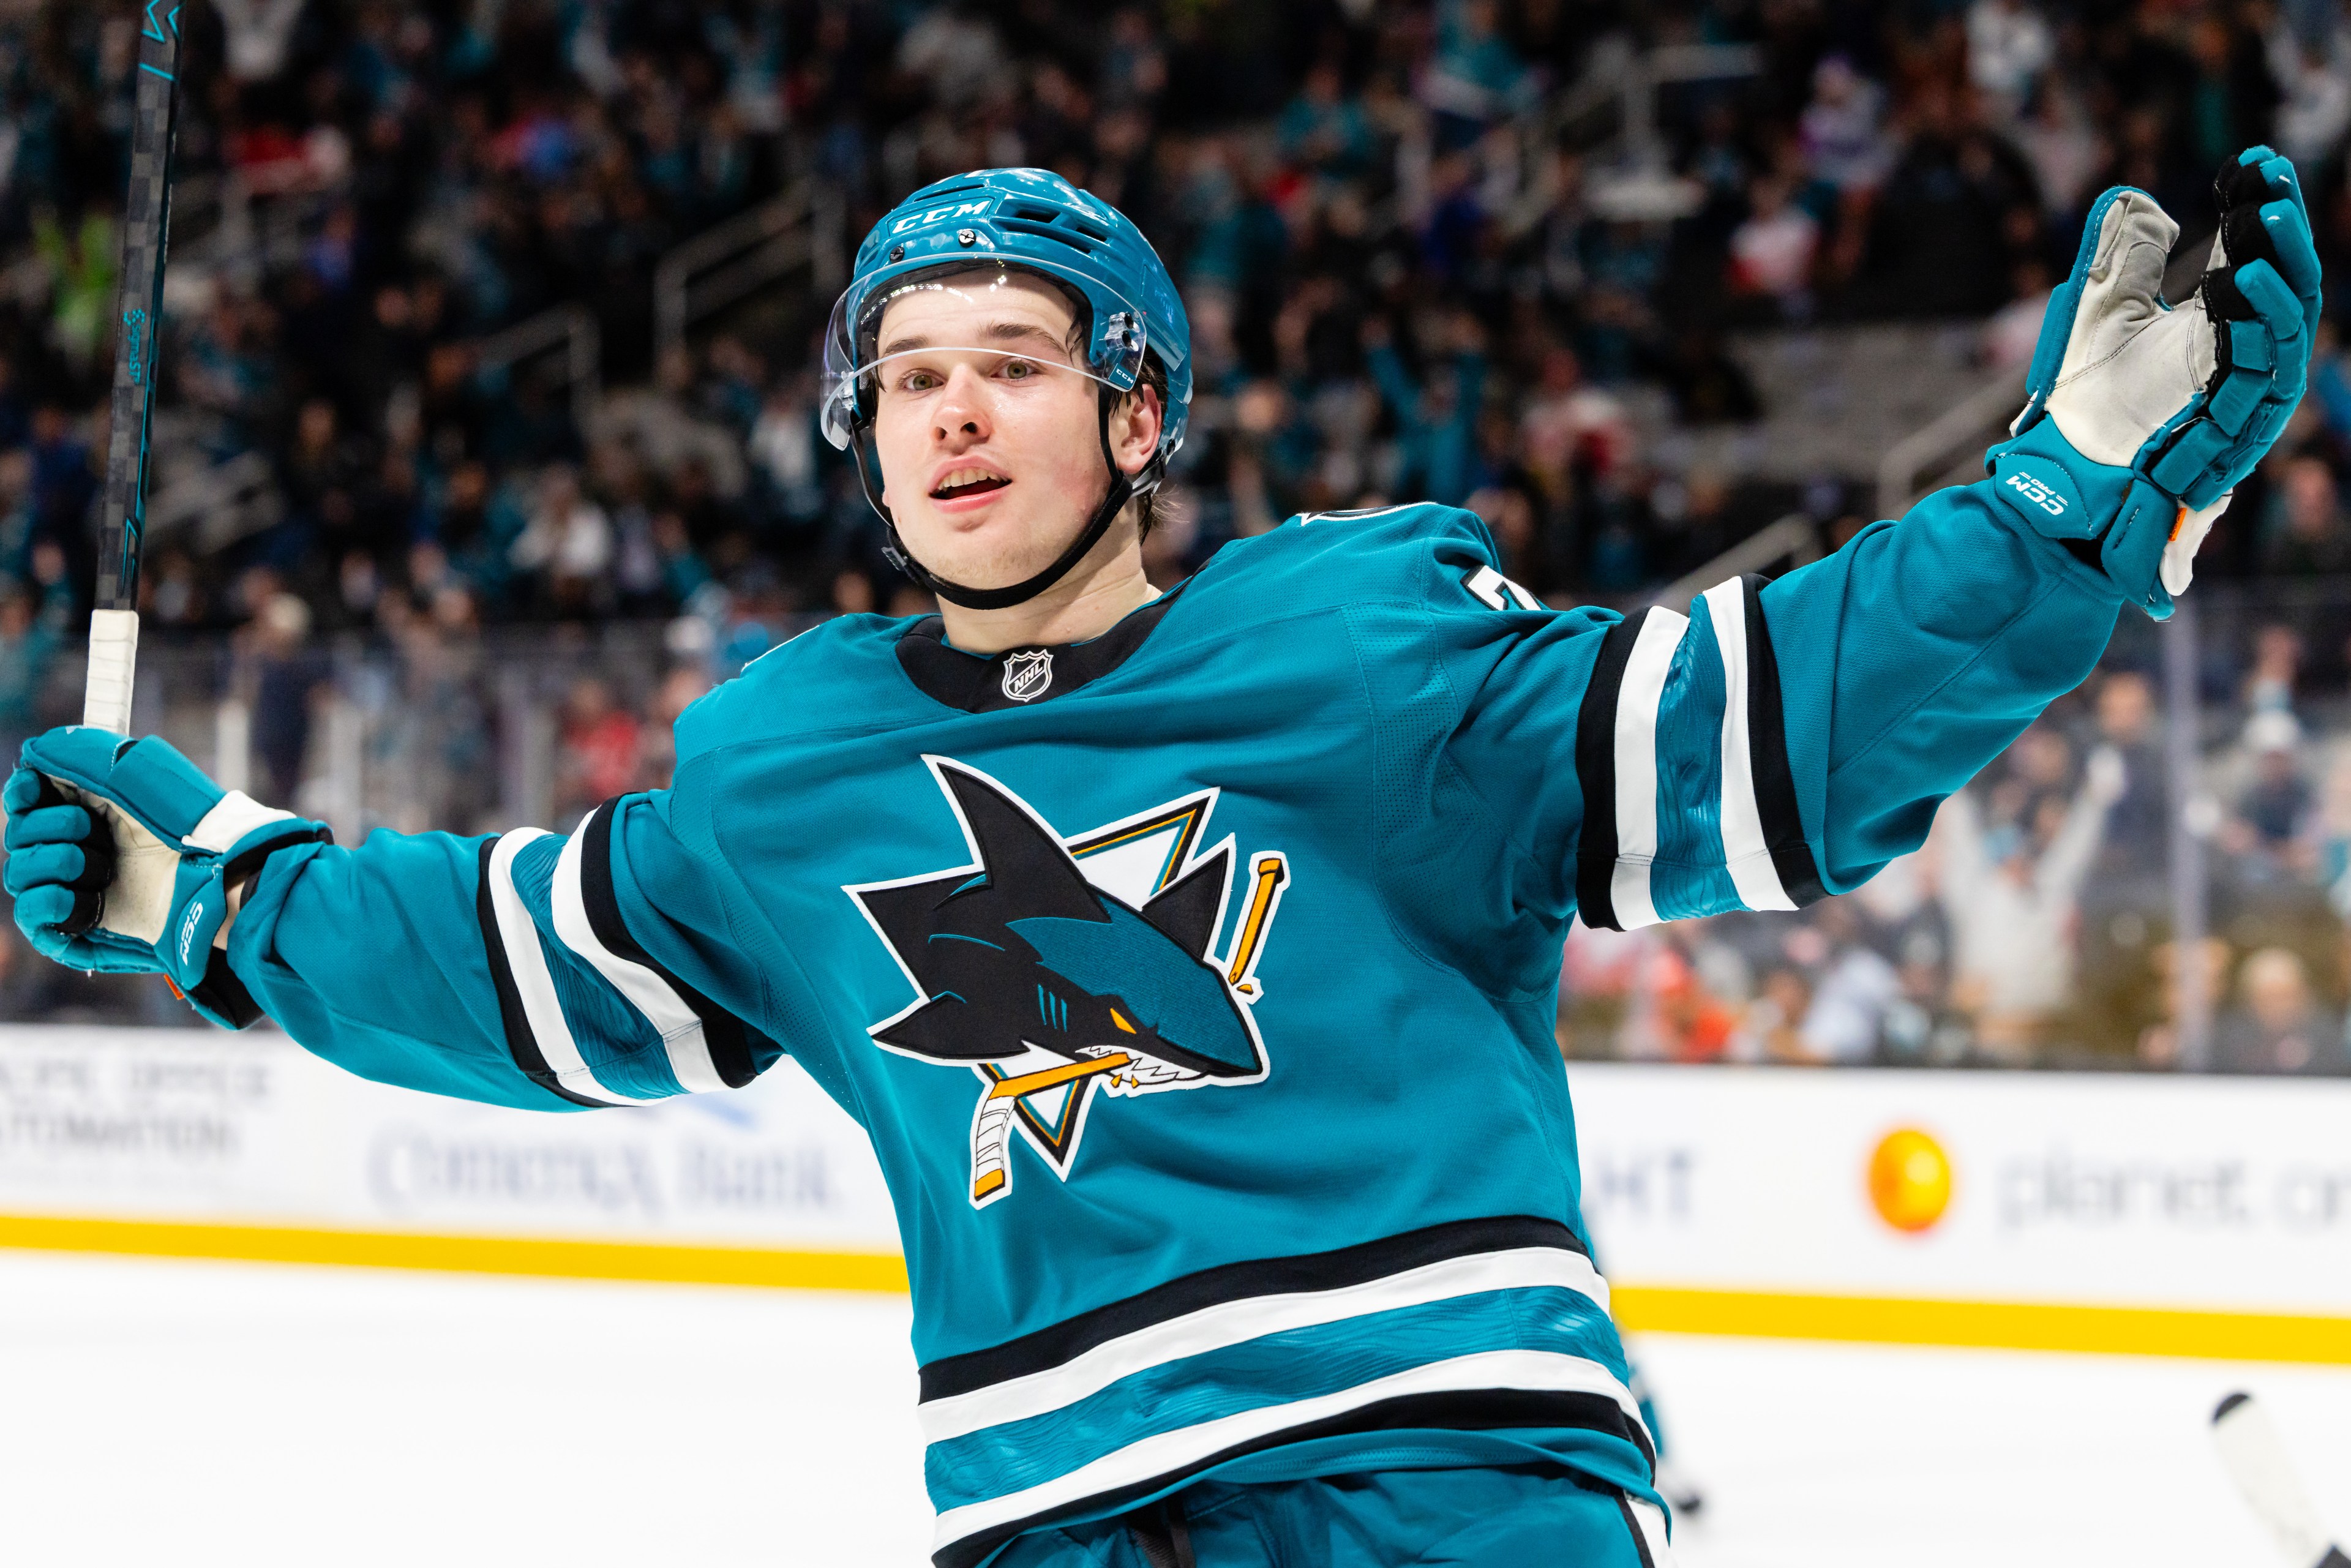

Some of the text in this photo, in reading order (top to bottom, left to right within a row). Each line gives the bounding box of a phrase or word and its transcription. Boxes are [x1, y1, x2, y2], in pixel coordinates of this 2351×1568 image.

[892, 200, 991, 234] CCM
[1116, 368, 1134, 384] CCM
[2005, 475, 2064, 516] CCM
[2030, 478, 2056, 495] PRO
[1013, 662, 1043, 692] NHL
[182, 902, 203, 966] CCM
